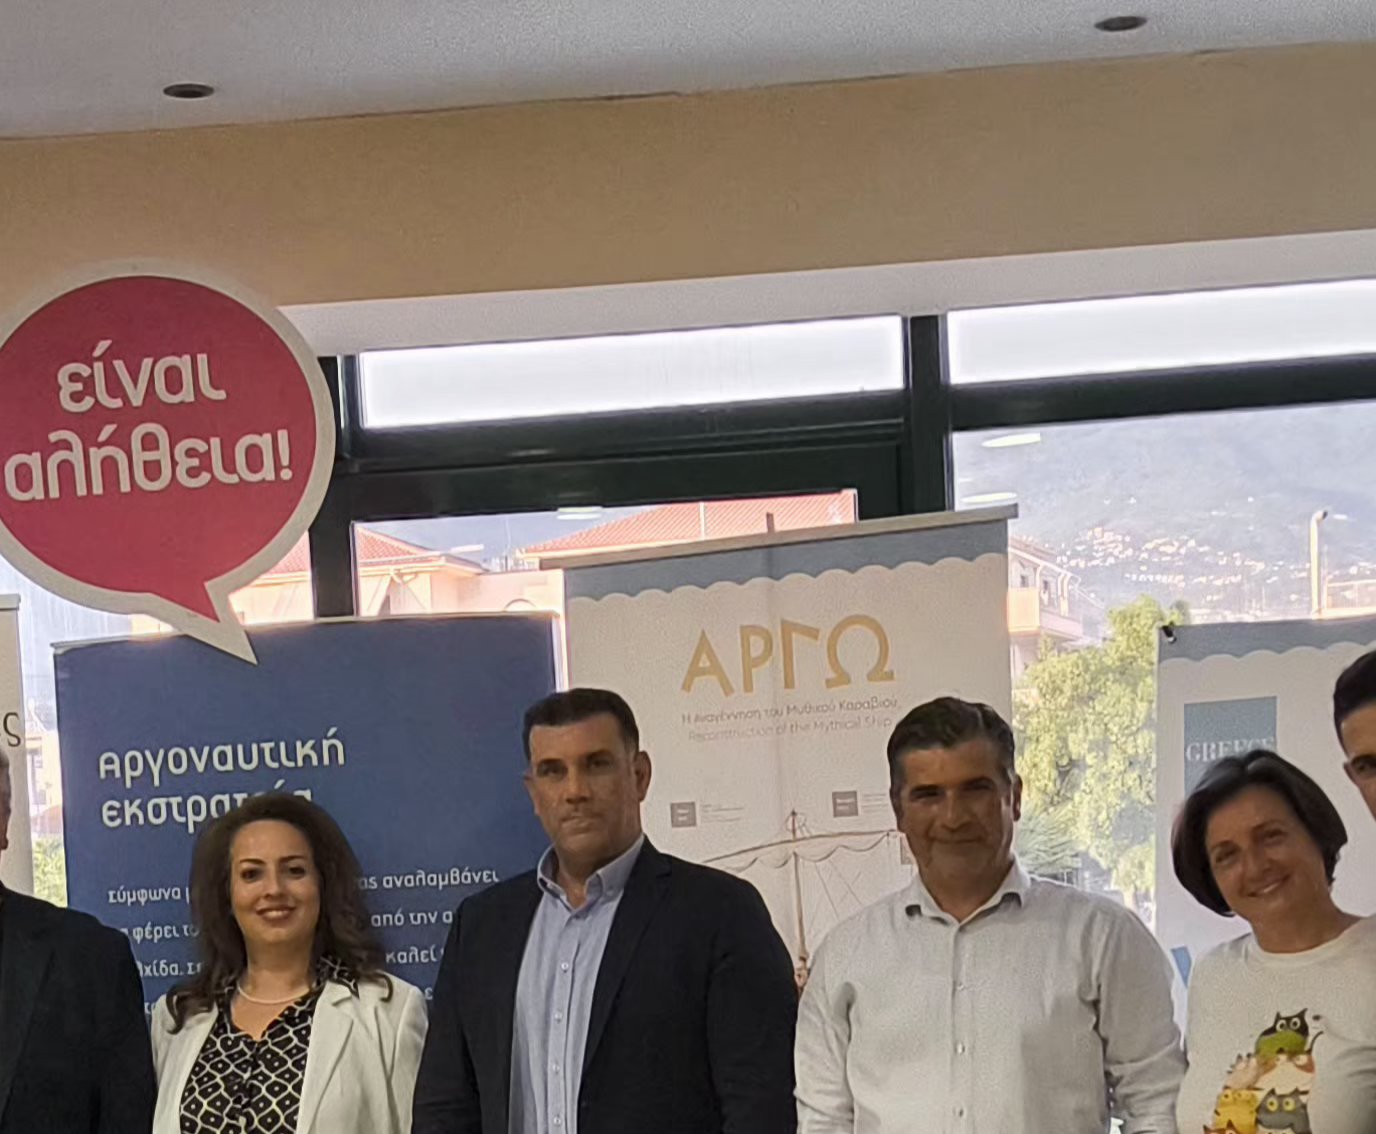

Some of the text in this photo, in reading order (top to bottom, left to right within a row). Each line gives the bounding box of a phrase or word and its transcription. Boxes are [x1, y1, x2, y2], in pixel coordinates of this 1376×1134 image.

[57, 339, 227, 413] είναι
[3, 422, 293, 502] αλήθεια!
[680, 613, 896, 697] ΑΡΓΩ
[99, 726, 346, 789] Αργοναυτική
[382, 866, 500, 891] αναλαμβάνει
[132, 921, 180, 945] φέρει
[371, 908, 405, 928] από
[385, 945, 438, 964] καλεί
